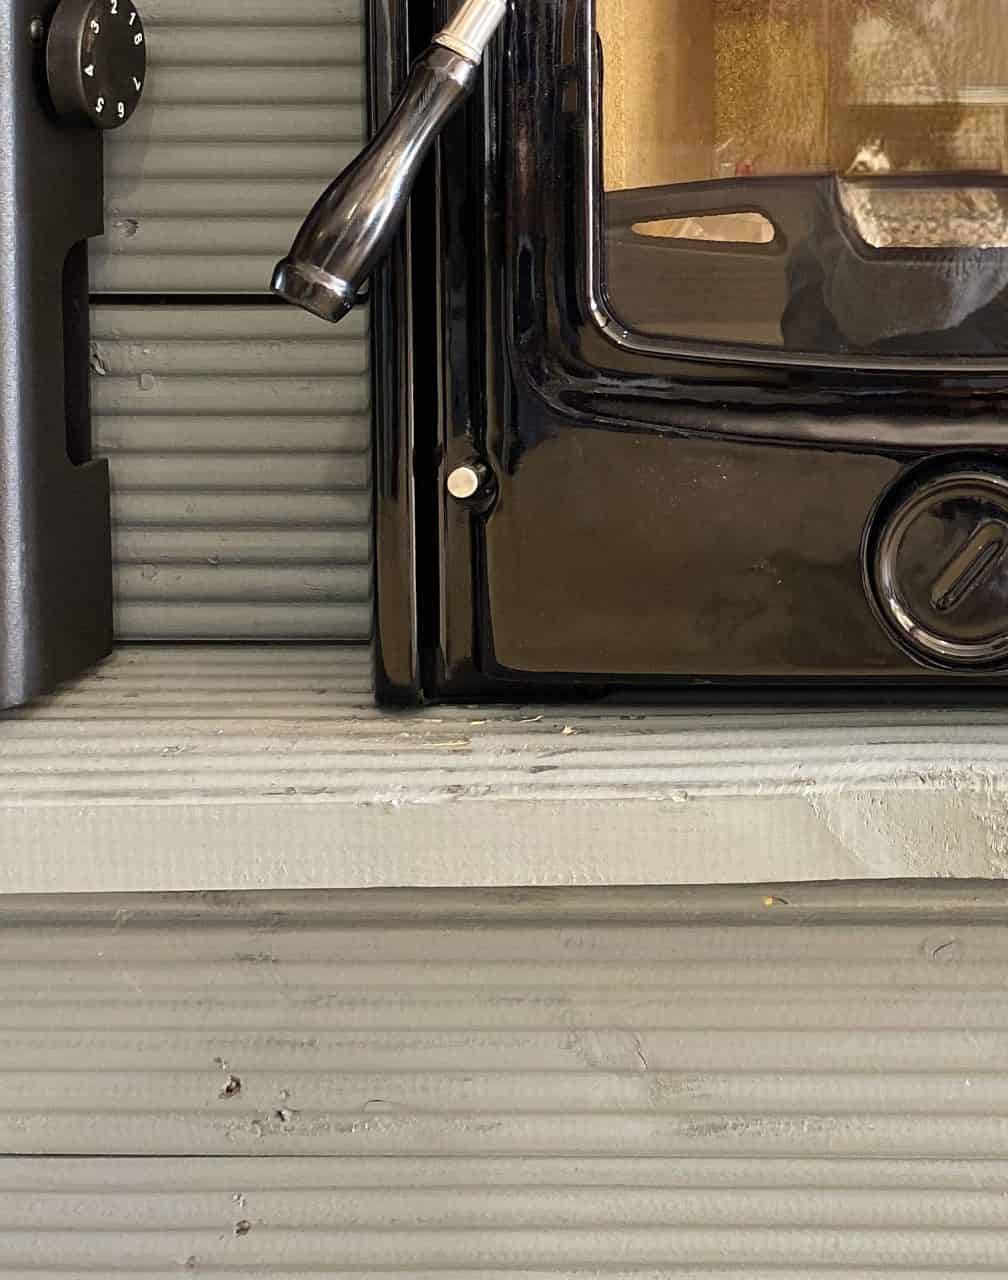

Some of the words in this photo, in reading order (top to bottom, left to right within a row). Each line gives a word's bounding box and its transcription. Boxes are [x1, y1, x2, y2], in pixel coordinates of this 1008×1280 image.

[129, 12, 136, 26] 1
[90, 19, 100, 34] 3
[134, 32, 143, 46] 8
[84, 64, 94, 77] 4
[95, 96, 105, 113] 5
